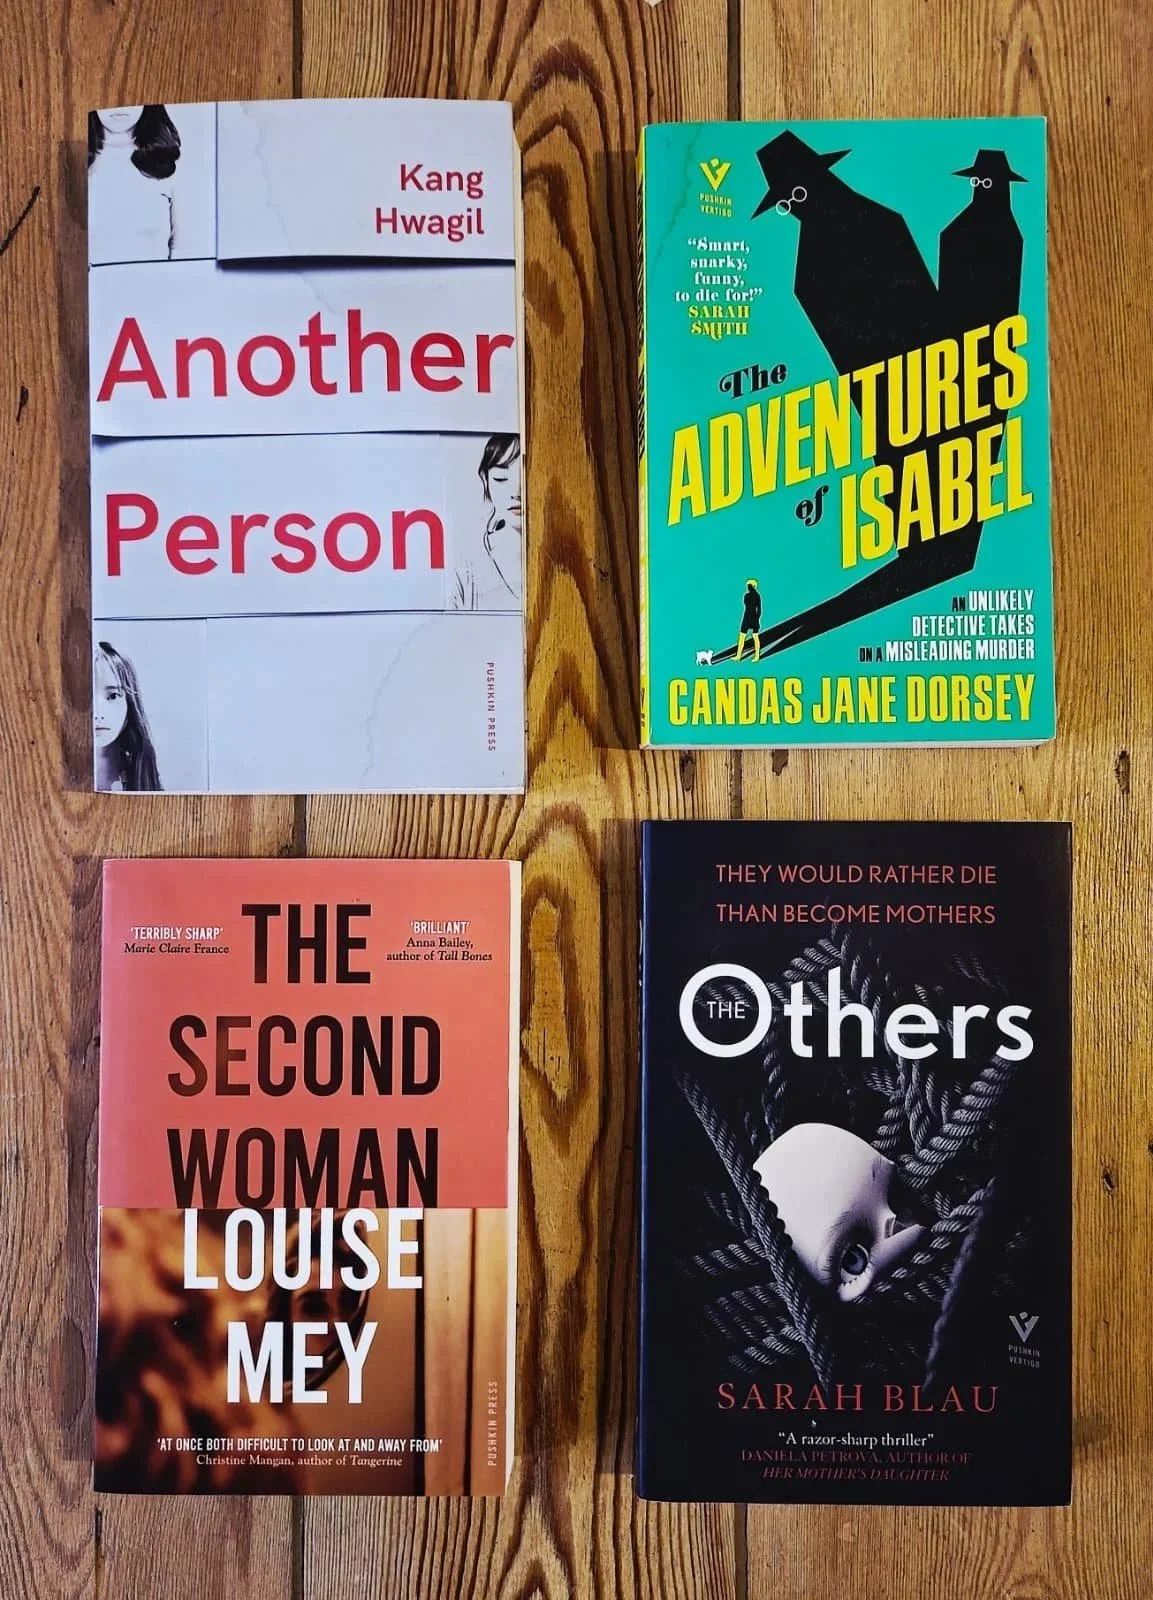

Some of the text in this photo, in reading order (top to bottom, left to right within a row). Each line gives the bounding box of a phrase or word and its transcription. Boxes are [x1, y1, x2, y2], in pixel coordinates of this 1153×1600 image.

[400, 164, 484, 199] Kang
[699, 192, 732, 206] PUSHKIN
[700, 204, 732, 217] VERTIGO
[375, 208, 485, 242] Hwagil
[688, 237, 750, 253] "Smart,
[690, 256, 748, 271] snarky,
[694, 272, 745, 287] funny,
[675, 287, 763, 302] to die for!"
[688, 305, 750, 318] SARAH
[691, 321, 748, 341] SMITH
[96, 309, 515, 402] Another
[719, 363, 787, 399] The
[667, 314, 1028, 526] ADVENTURES
[795, 416, 1033, 569] of ISABEL
[106, 493, 445, 577] Person
[952, 589, 1034, 612] AN UNLIKELY
[912, 614, 1035, 637] DETECTIVE TAKES
[859, 639, 1035, 663] ON A MISLEADING MURDER
[486, 662, 497, 752] PUSHKIN PRESS
[668, 677, 803, 726] CANDAS
[812, 675, 898, 724] JANE
[906, 673, 1036, 723] DORSEY
[716, 864, 998, 885] THEY WOULD RATHER DIE
[716, 903, 997, 925] THAN BECOME MOTHERS
[130, 926, 224, 940] 'TERRIBLY SHARP'
[410, 920, 471, 934] 'BRILLIANT'
[124, 942, 230, 954] Marie Claire France
[241, 903, 372, 985] THE
[406, 937, 474, 950] Anna Bailey,
[386, 950, 493, 962] author of Tall Bones
[679, 963, 1034, 1060] Others
[706, 1000, 746, 1020] THE
[167, 1014, 441, 1098] SECOND
[166, 1127, 440, 1209] WOMAN
[183, 1207, 424, 1292] LOUISE
[1008, 1344, 1041, 1359] PUSHKIN
[226, 1321, 379, 1404] MEY
[717, 1382, 1000, 1414] SARAH BLAU
[487, 1381, 498, 1467] PUSHKIN PRESS
[157, 1437, 443, 1453] 'AT ONCE BOTH DIFFICULT TO LOOK AT AND AWAY FROM'
[777, 1432, 934, 1449] "A razor-sharp thriller"
[196, 1454, 403, 1468] Christine Mangan, author of Tangerine
[741, 1449, 972, 1465] DANIELA PETROVA, AUTHOR OF
[762, 1466, 950, 1482] HER MOTHER'S DAUGHTER
